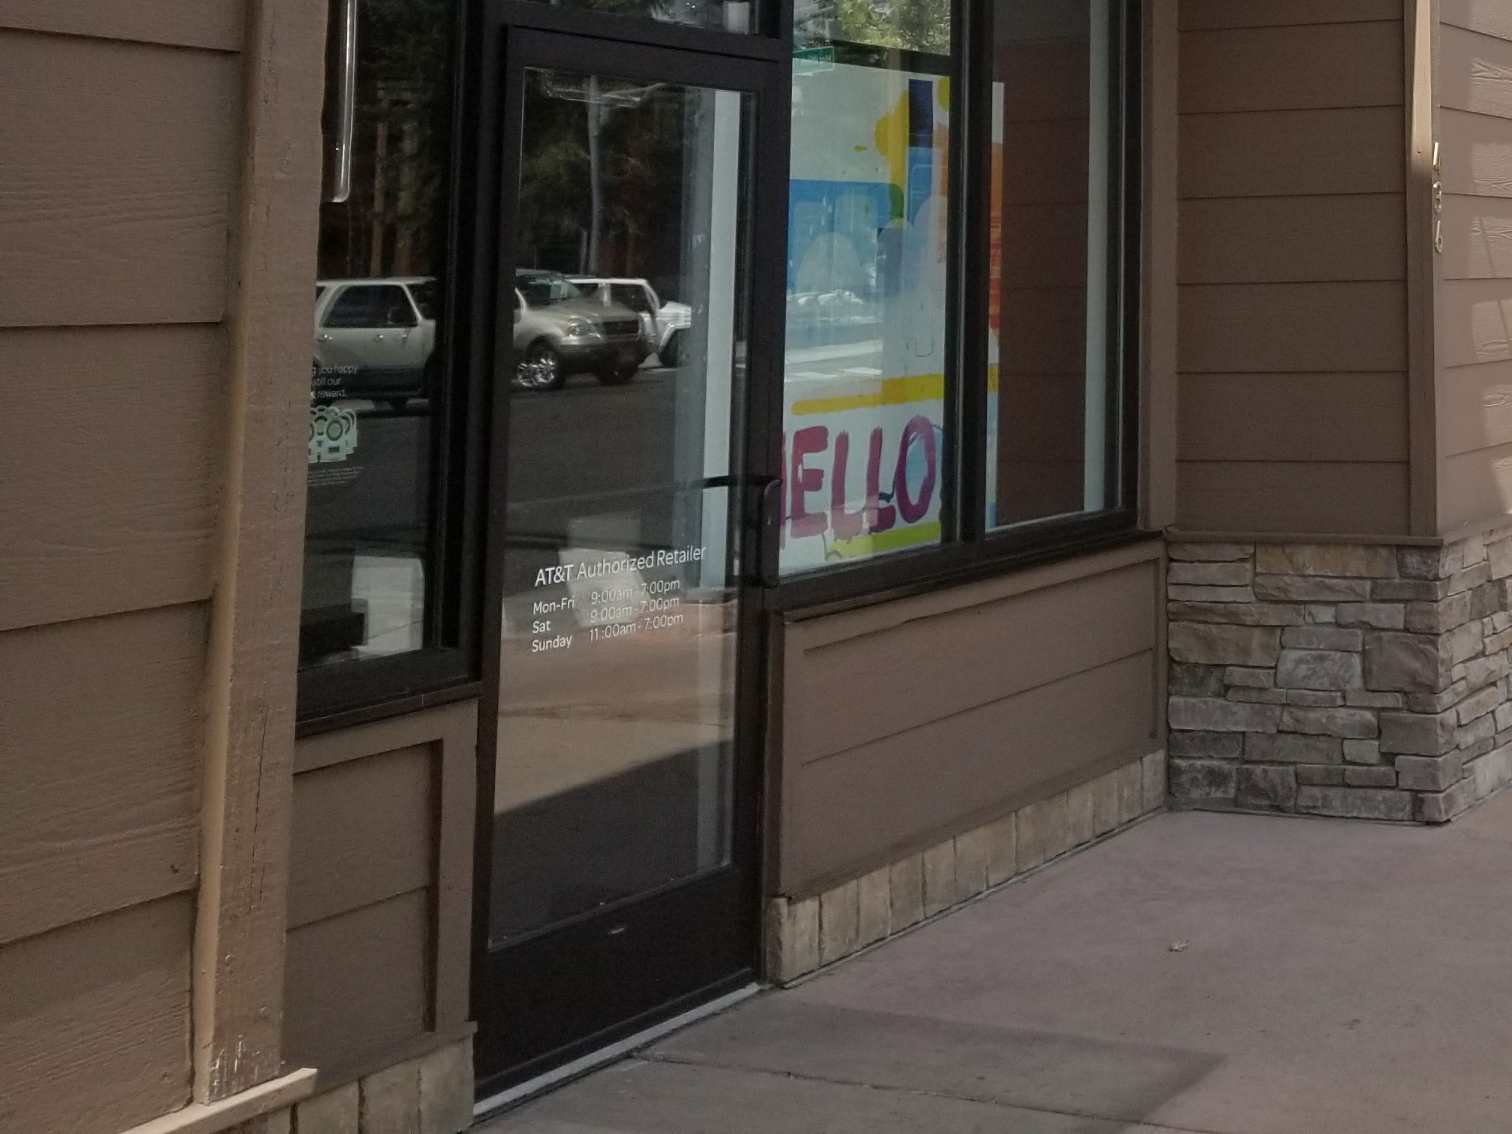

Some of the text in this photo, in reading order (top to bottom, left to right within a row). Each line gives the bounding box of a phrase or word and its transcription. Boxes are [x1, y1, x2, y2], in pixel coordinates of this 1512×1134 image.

[534, 545, 706, 587] AT&T Authorized Retailer
[532, 595, 575, 616] Mon-Fri
[532, 619, 551, 634] Sat
[531, 635, 573, 653] Sunday
